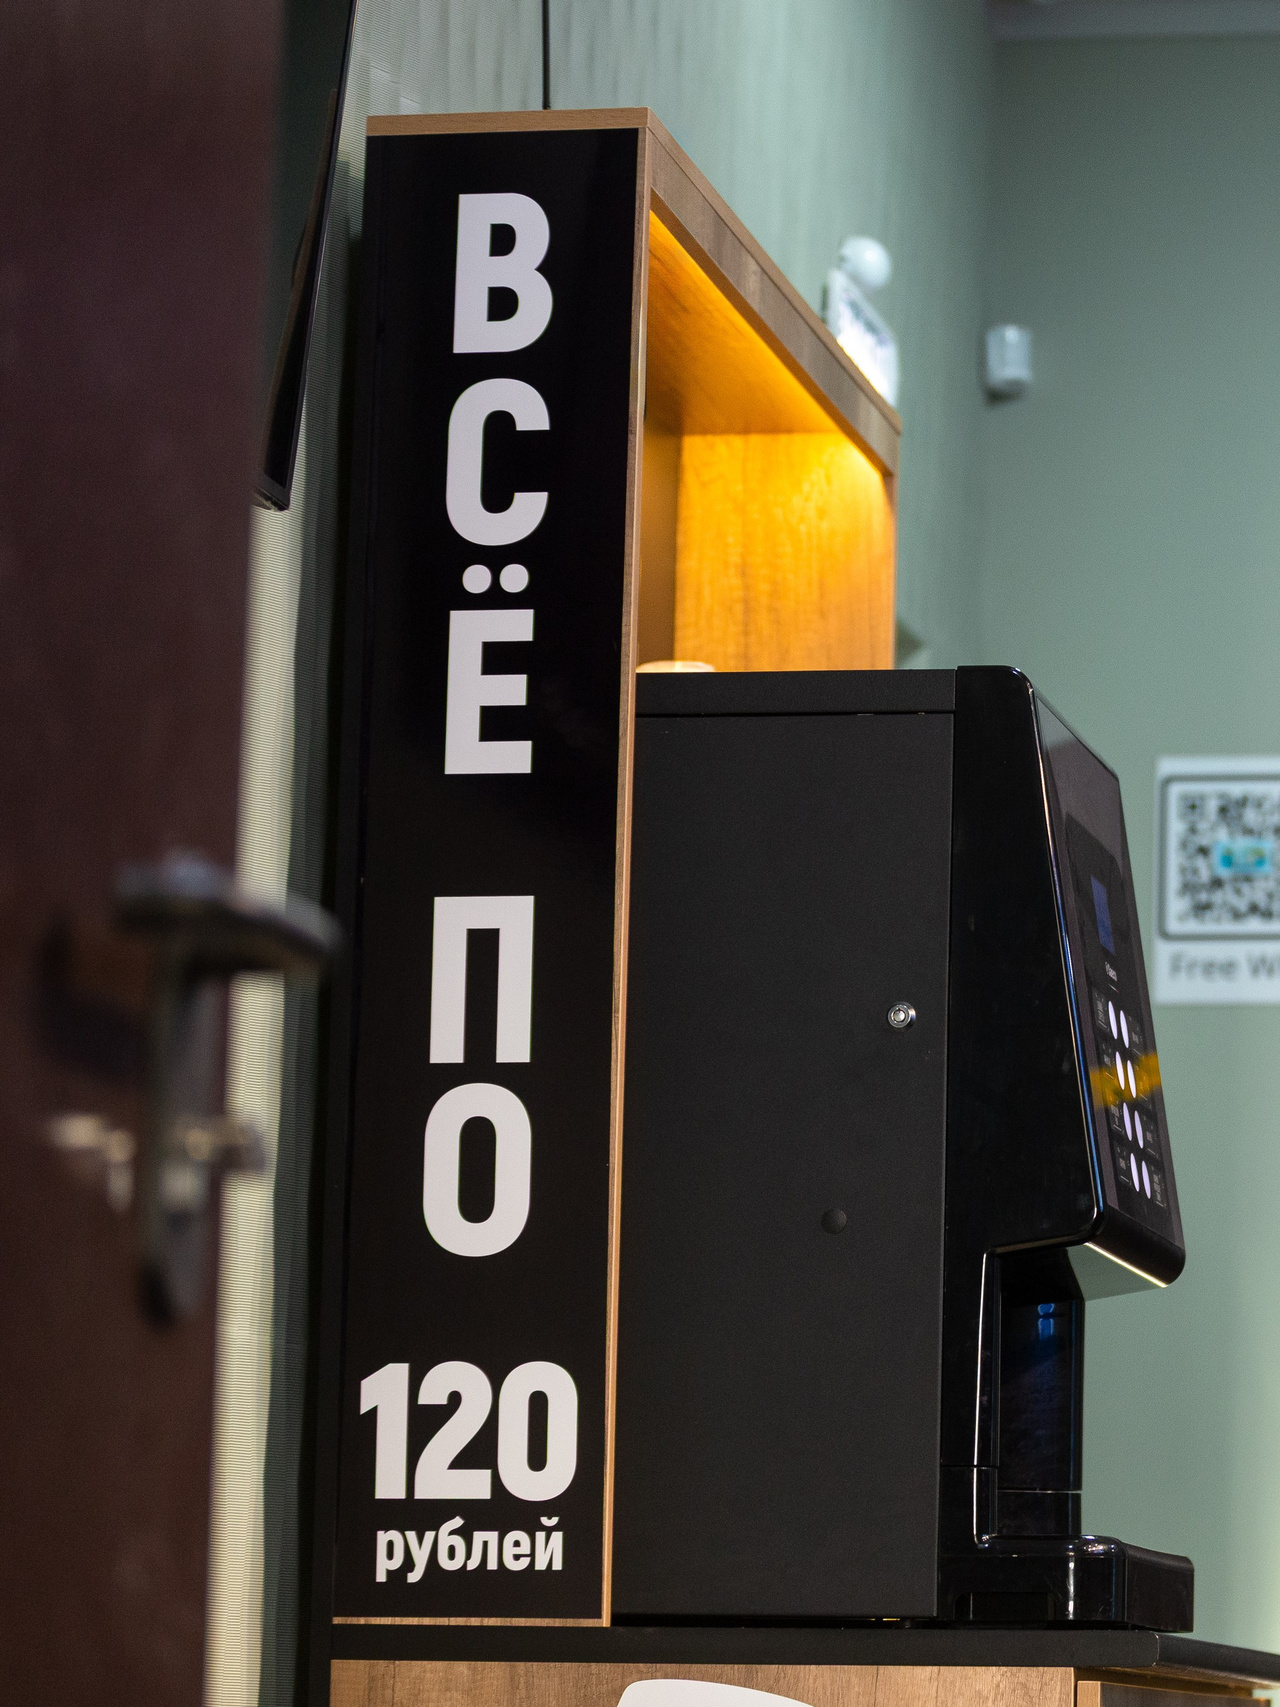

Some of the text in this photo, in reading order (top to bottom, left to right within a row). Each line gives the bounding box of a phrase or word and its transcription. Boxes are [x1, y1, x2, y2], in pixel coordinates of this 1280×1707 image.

[423, 193, 552, 1256] ВСЁ ПО
[1170, 953, 1239, 981] Free
[360, 1361, 578, 1501] 120
[376, 1516, 563, 1582] рублей
